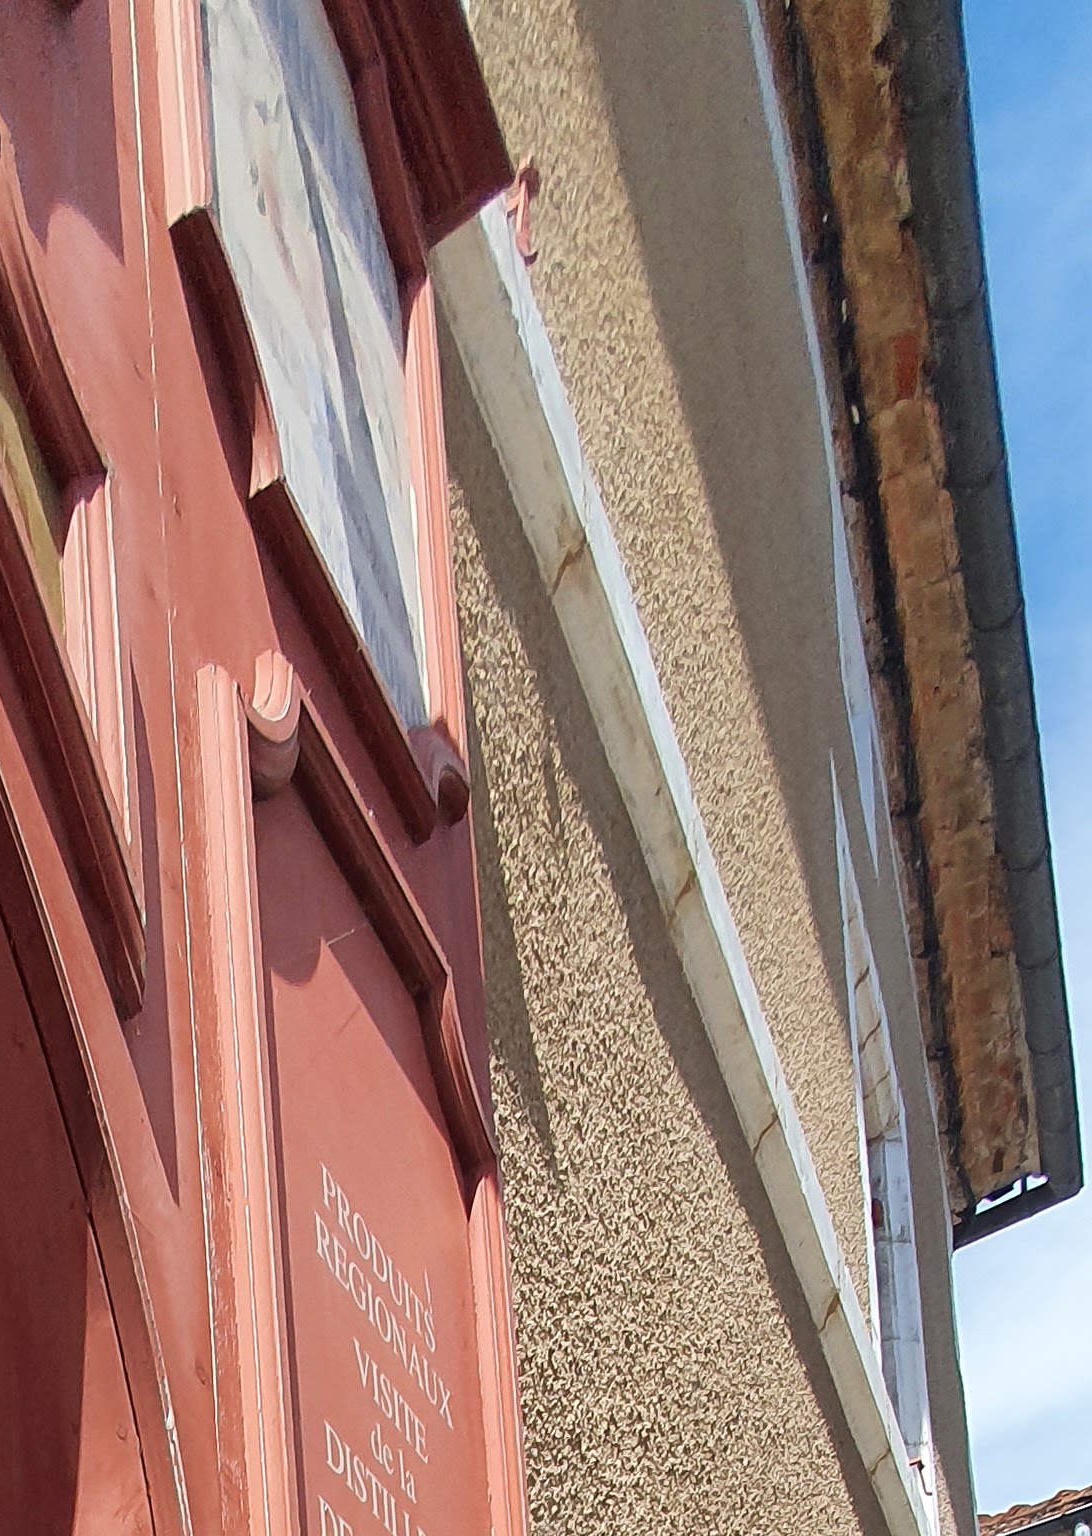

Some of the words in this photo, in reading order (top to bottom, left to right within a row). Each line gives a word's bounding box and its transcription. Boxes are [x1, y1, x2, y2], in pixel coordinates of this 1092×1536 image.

[313, 1209, 454, 1430] REGIONAUX
[320, 1161, 436, 1353] PRODUITS
[353, 1337, 429, 1464] VISITE
[370, 1423, 395, 1476] de
[398, 1450, 418, 1504] la
